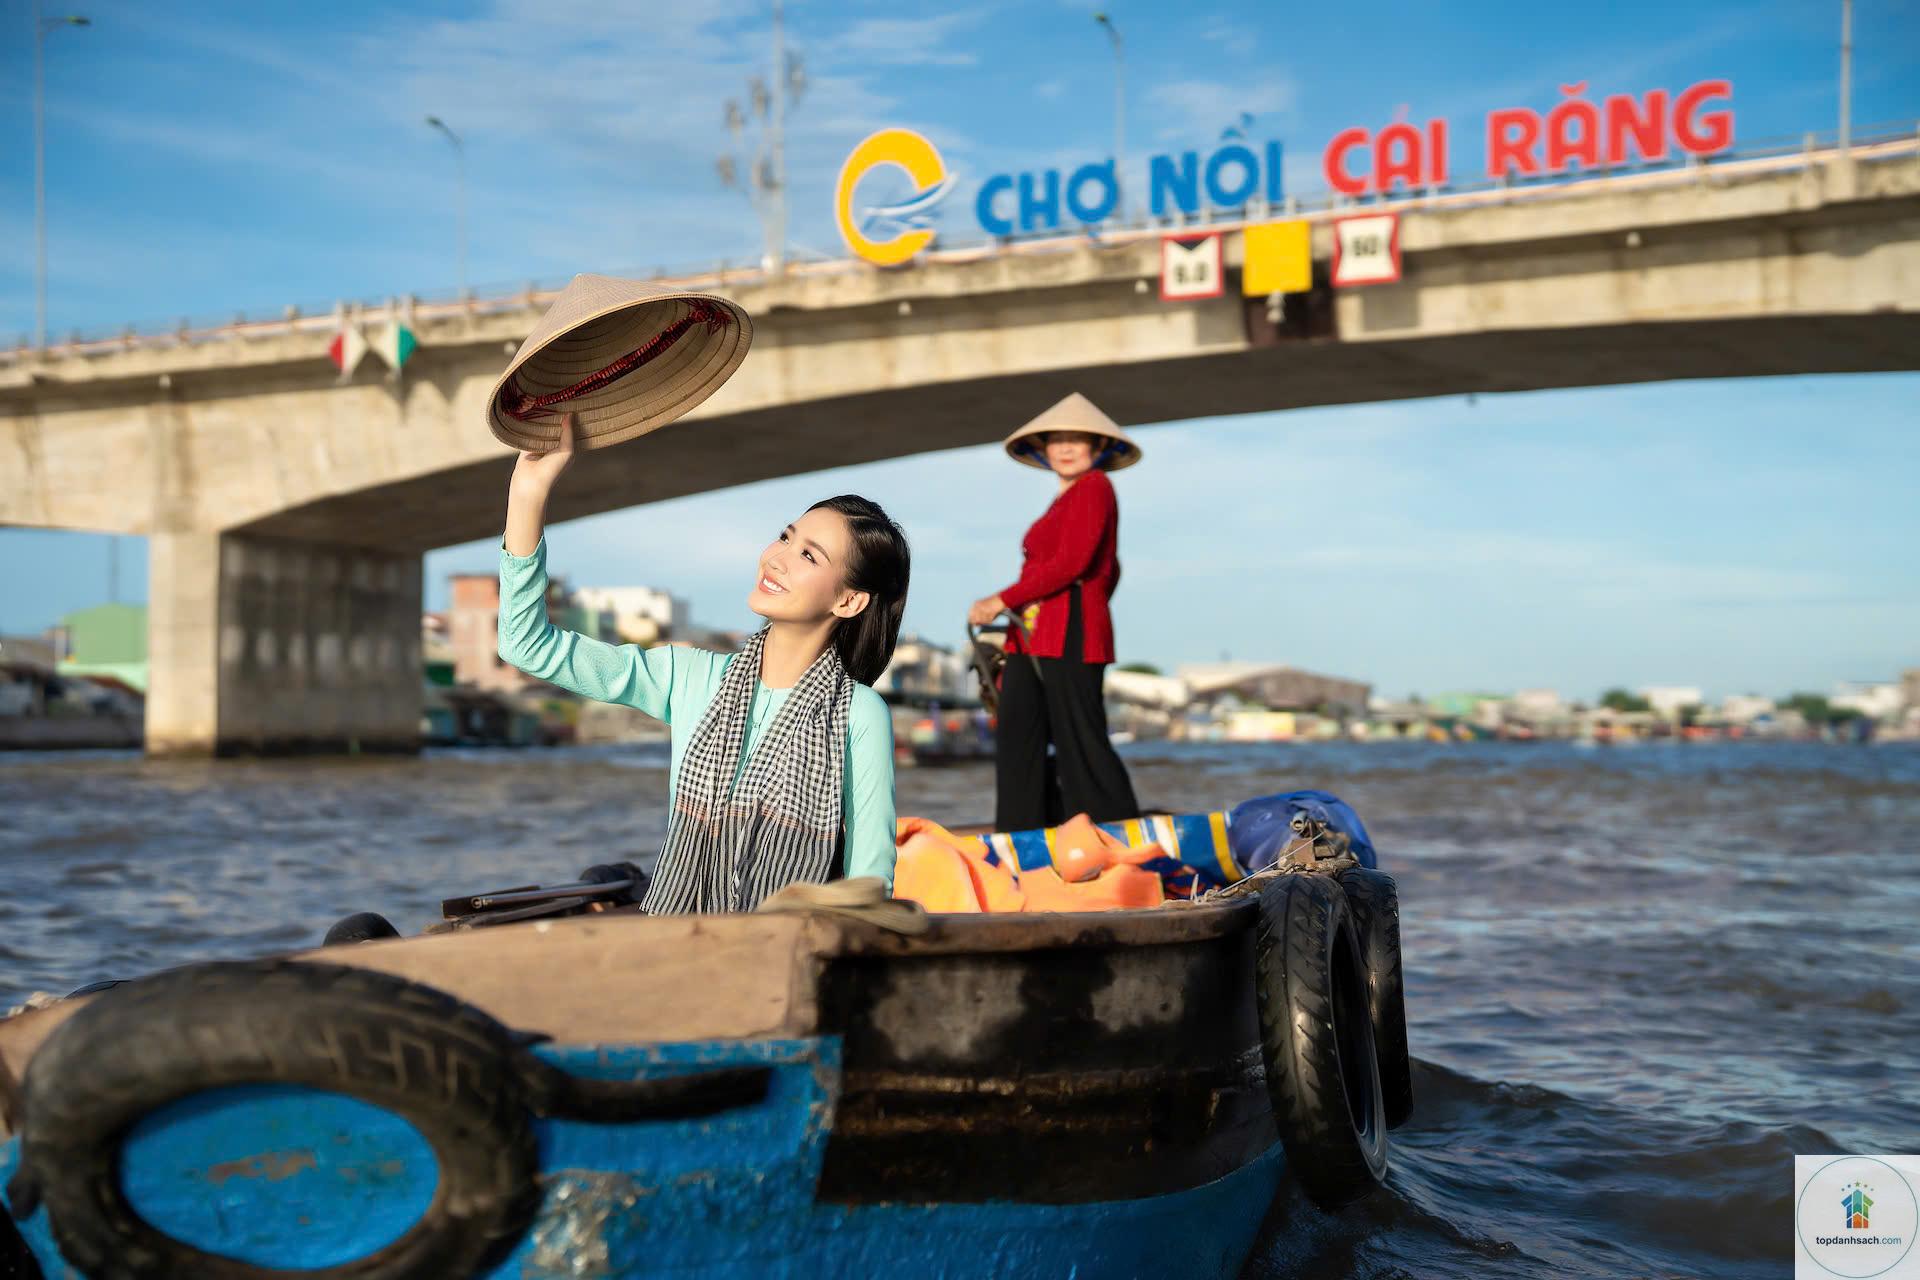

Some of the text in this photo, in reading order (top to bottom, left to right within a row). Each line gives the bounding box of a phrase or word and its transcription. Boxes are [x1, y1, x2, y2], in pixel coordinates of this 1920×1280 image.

[1150, 112, 1285, 216] NỔI
[1323, 104, 1450, 196] CÁI
[1486, 79, 1735, 178] RĂNG
